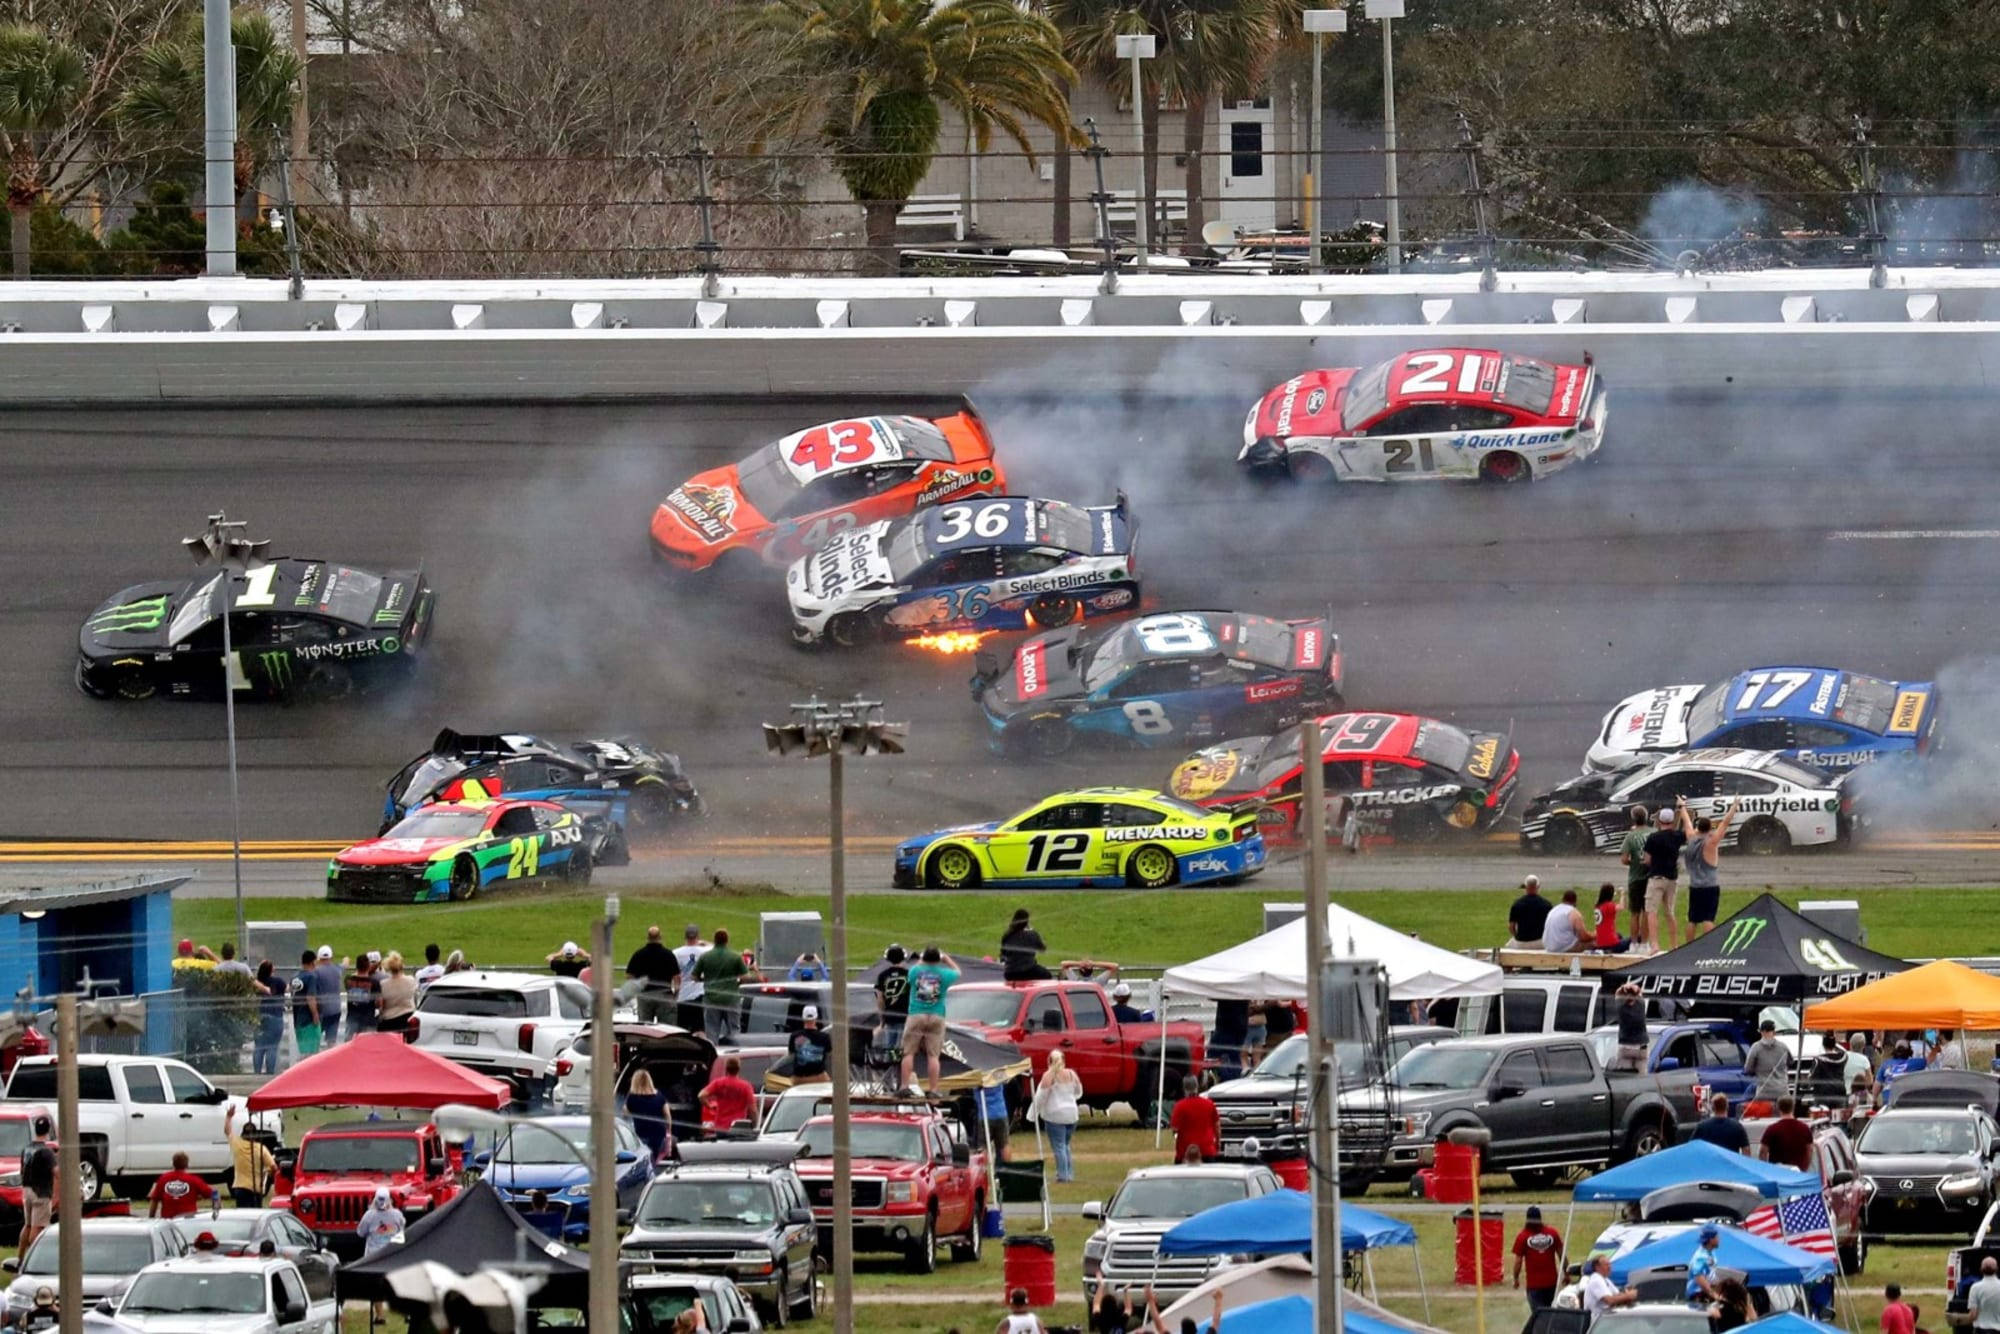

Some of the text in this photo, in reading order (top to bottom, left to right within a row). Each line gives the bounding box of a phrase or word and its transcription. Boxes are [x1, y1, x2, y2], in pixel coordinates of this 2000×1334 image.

[1400, 354, 1482, 394] 21
[1276, 374, 1305, 436] Motorcraft
[789, 420, 876, 473] 43
[1382, 438, 1437, 473] 21
[1468, 432, 1561, 448] Quick Lane
[936, 503, 1012, 544] 36
[849, 533, 874, 587] Select
[235, 564, 278, 608] 1
[1010, 570, 1106, 594] SelectBlinds
[931, 584, 992, 621] 36
[1135, 614, 1219, 653] 8
[1301, 630, 1316, 664] Lenovo
[1021, 645, 1038, 693] Lenovo
[1250, 684, 1297, 699] Lenovo
[1736, 671, 1812, 711] 17
[1122, 700, 1174, 735] 8
[1321, 711, 1401, 753] 19
[1641, 687, 1682, 748] FASTENA
[1798, 749, 1877, 767] FASTENAL
[1351, 784, 1462, 806] TRACKER
[1712, 798, 1820, 817] Smithfield
[1350, 809, 1393, 819] OATS
[1025, 831, 1092, 873] 12
[1105, 827, 1208, 843] MENARDS
[506, 836, 542, 880] 24
[1188, 859, 1231, 874] PEAK
[1800, 938, 1860, 971] 41
[1626, 975, 1780, 995] KURT BUSCH
[1817, 973, 1863, 993] KURT
